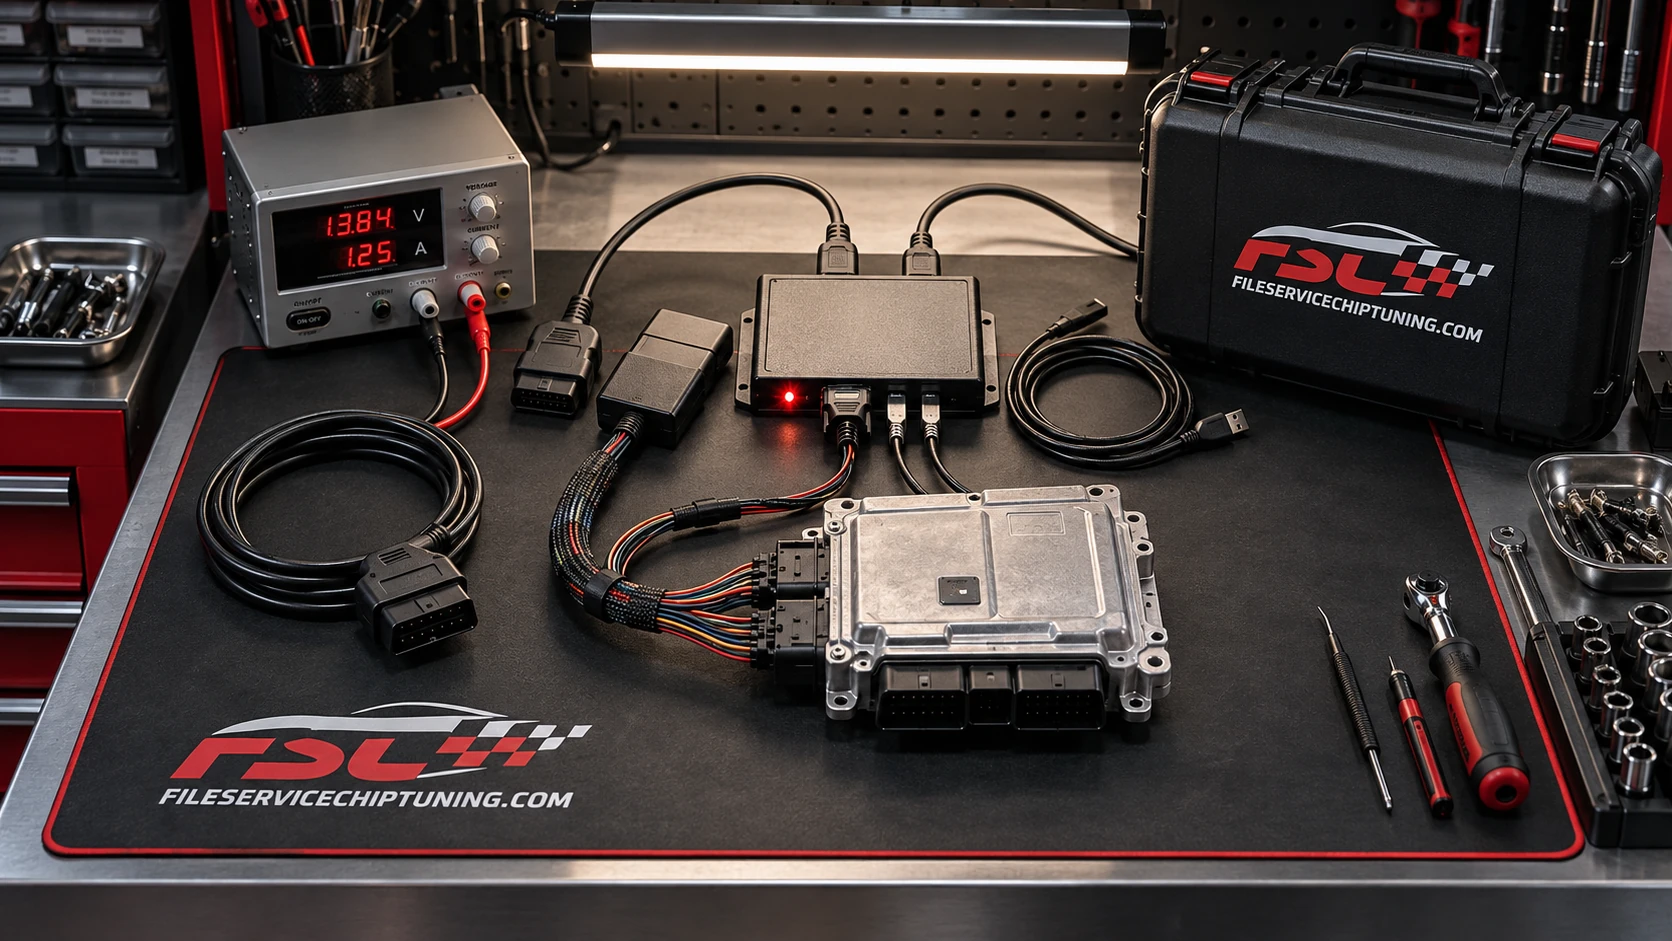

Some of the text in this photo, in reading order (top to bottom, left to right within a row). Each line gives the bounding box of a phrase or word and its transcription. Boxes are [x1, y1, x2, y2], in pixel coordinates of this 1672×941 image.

[413, 208, 425, 222] V
[415, 241, 428, 256] A
[1231, 275, 1483, 343] FILESERVICECHIPTUNING.COM
[158, 788, 574, 809] FILESERVICECHIPTUNING.COM
